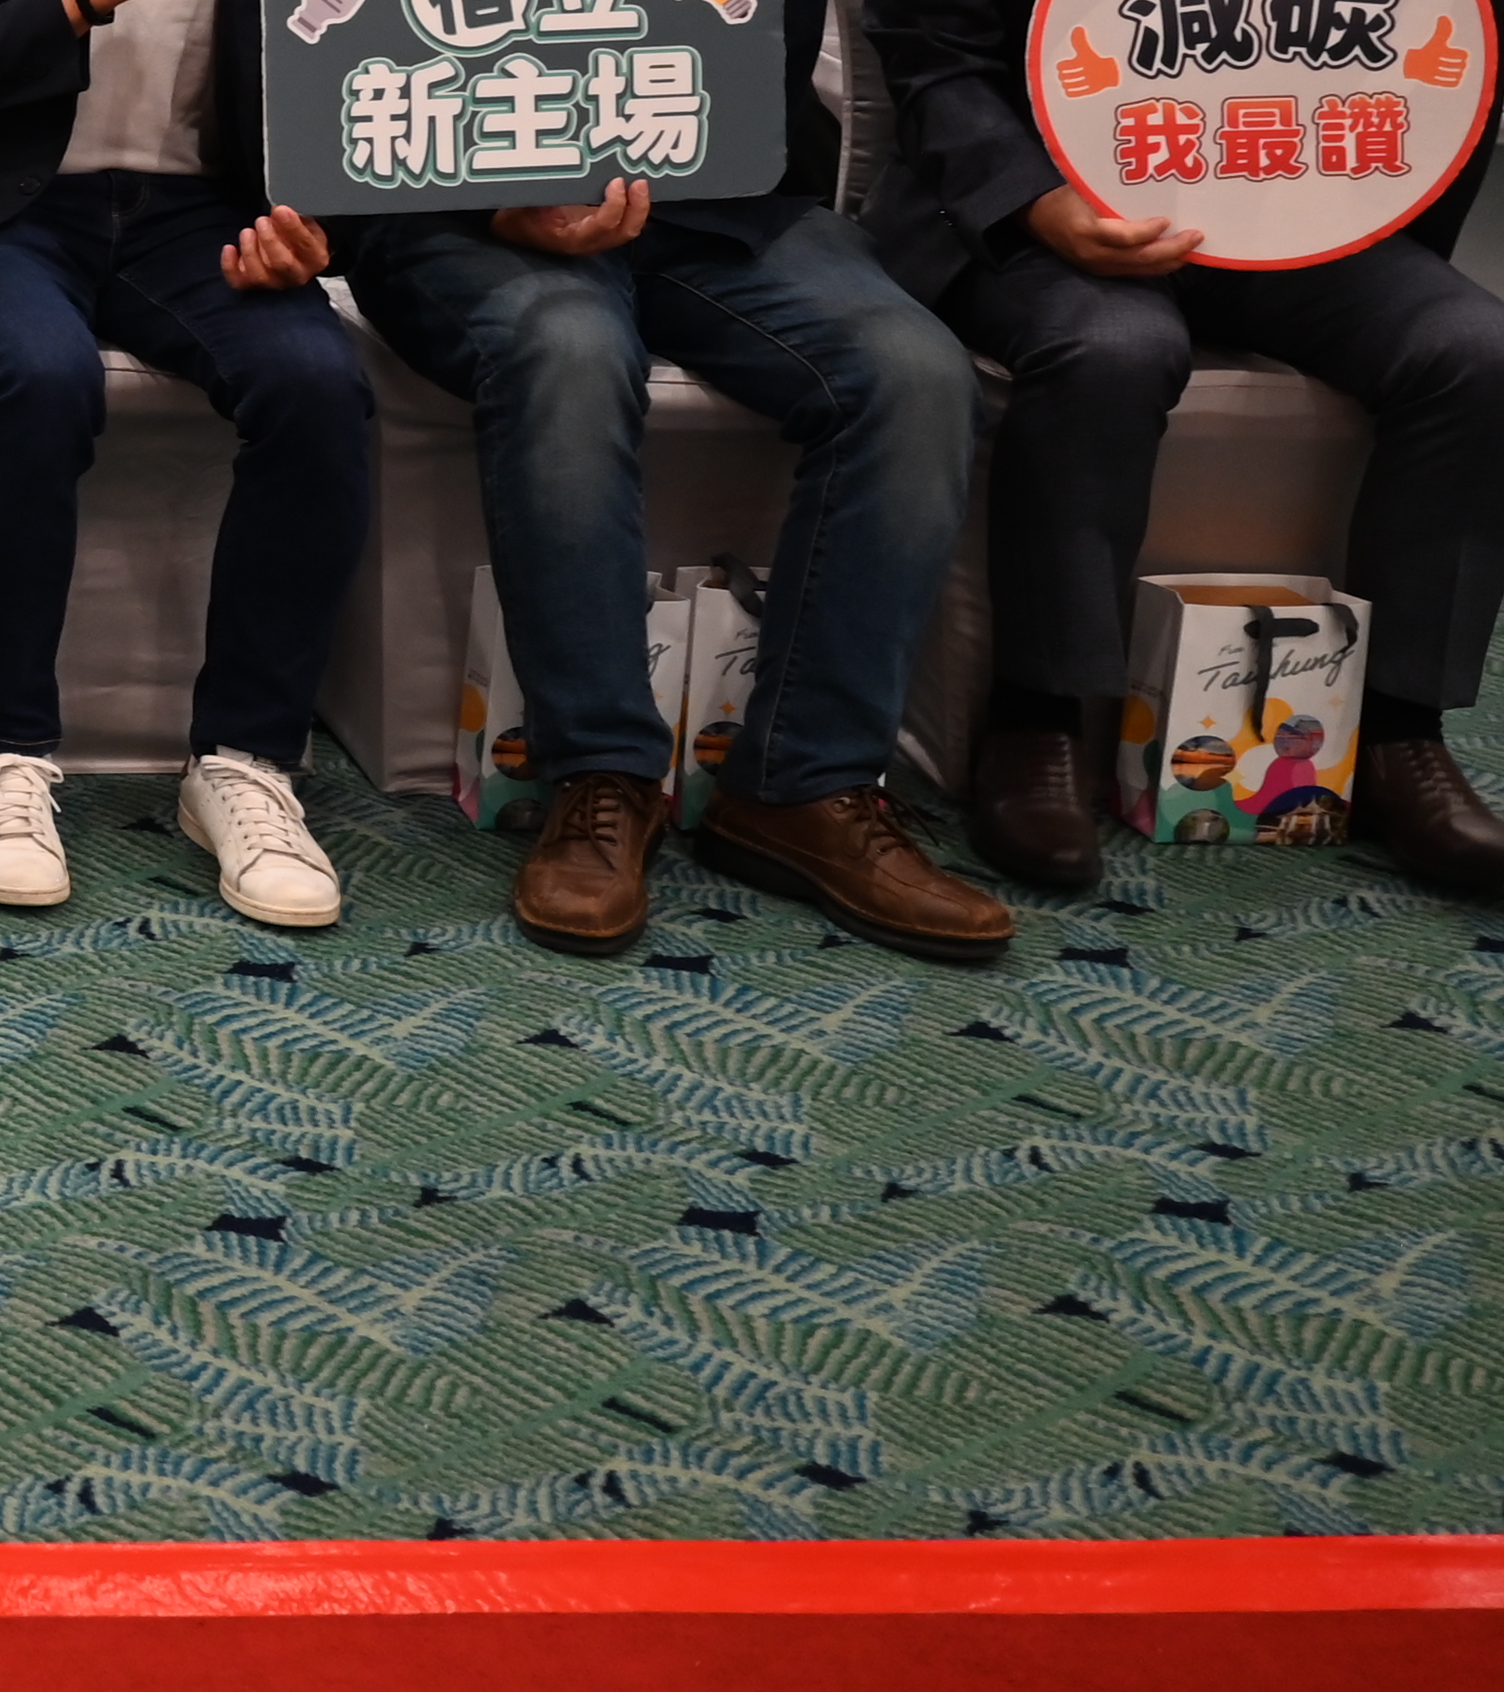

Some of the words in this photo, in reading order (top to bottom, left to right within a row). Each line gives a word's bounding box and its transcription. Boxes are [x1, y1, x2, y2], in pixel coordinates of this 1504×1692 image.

[348, 48, 702, 177] 新主場
[1116, 93, 1409, 183] 我最讚
